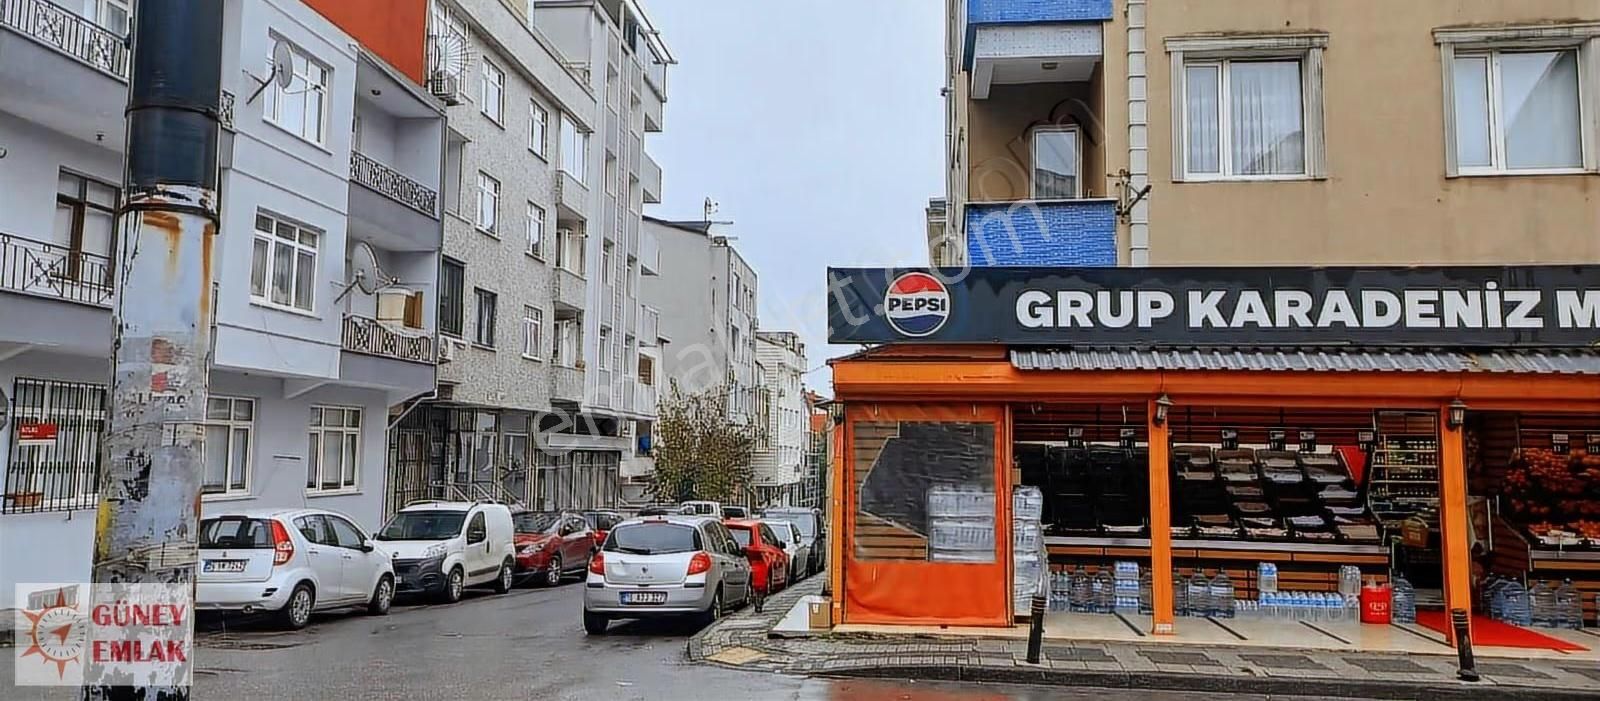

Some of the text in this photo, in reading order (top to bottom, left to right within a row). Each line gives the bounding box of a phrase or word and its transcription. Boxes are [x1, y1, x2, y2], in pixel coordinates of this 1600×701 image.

[888, 297, 946, 312] PEPSI
[1015, 289, 1175, 328] GRUP
[1188, 281, 1544, 328] KARADENİZ
